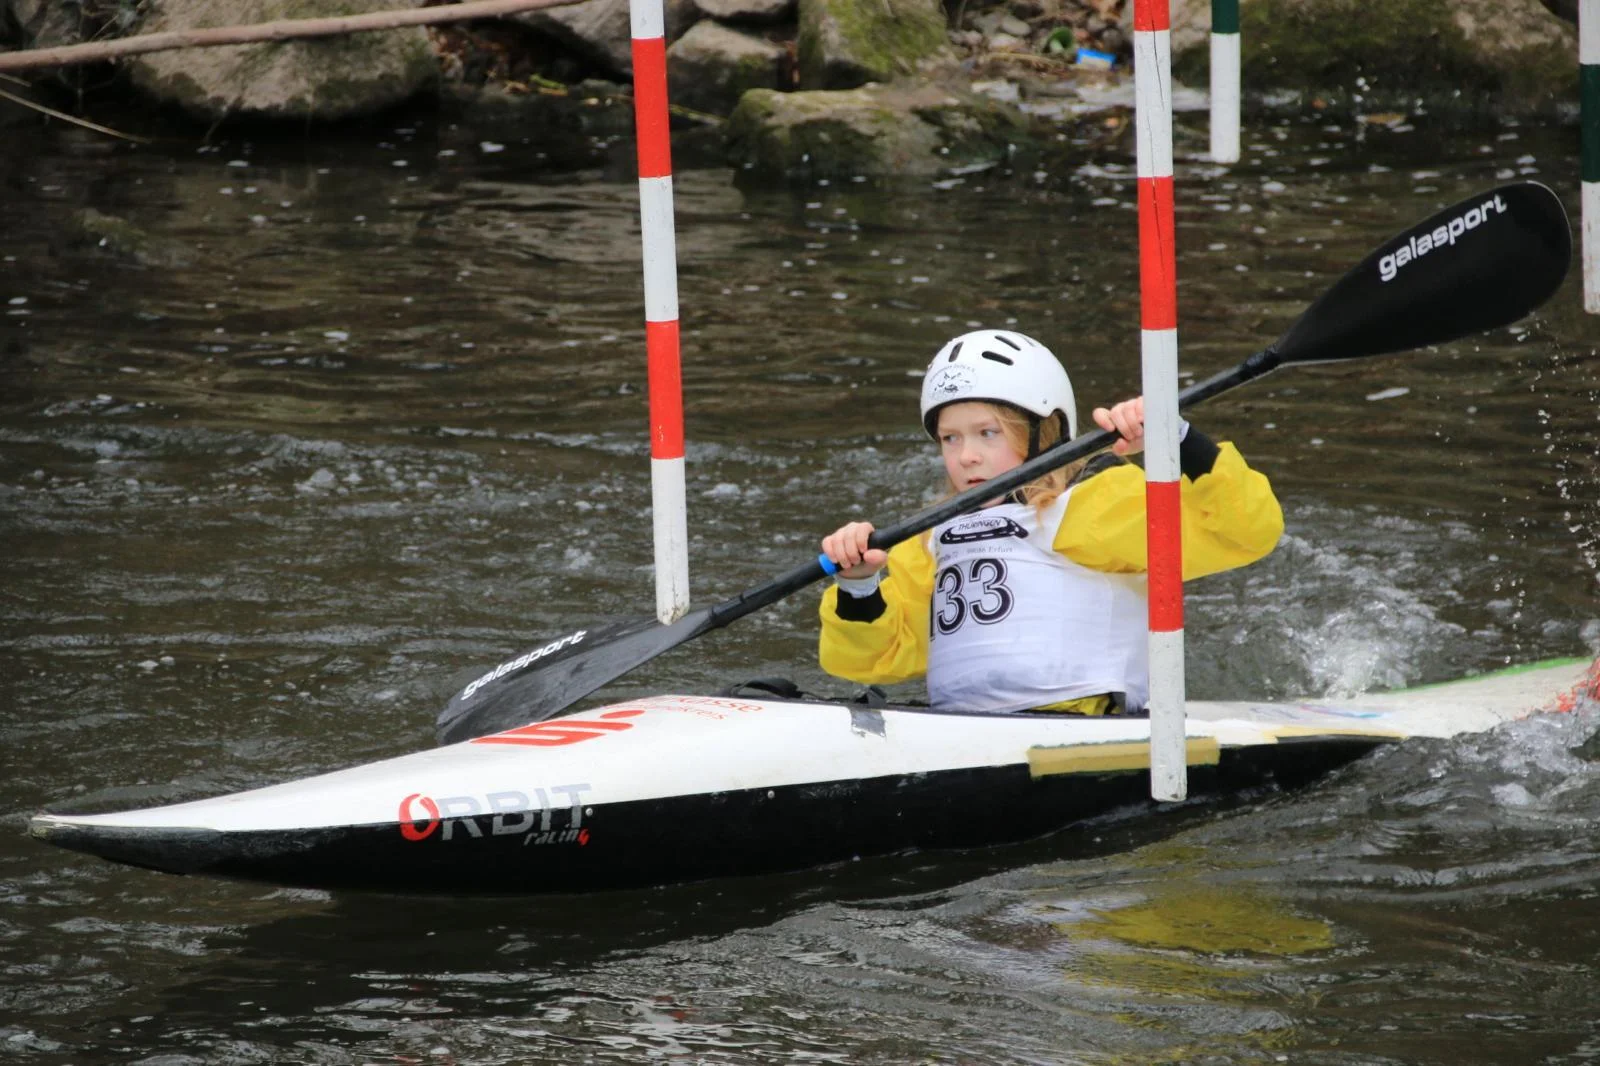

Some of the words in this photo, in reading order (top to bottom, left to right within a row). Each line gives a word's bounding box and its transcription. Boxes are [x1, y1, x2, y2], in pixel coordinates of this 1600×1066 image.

[1379, 193, 1507, 281] galasport
[460, 630, 588, 700] galasport
[398, 782, 592, 842] ORBIT
